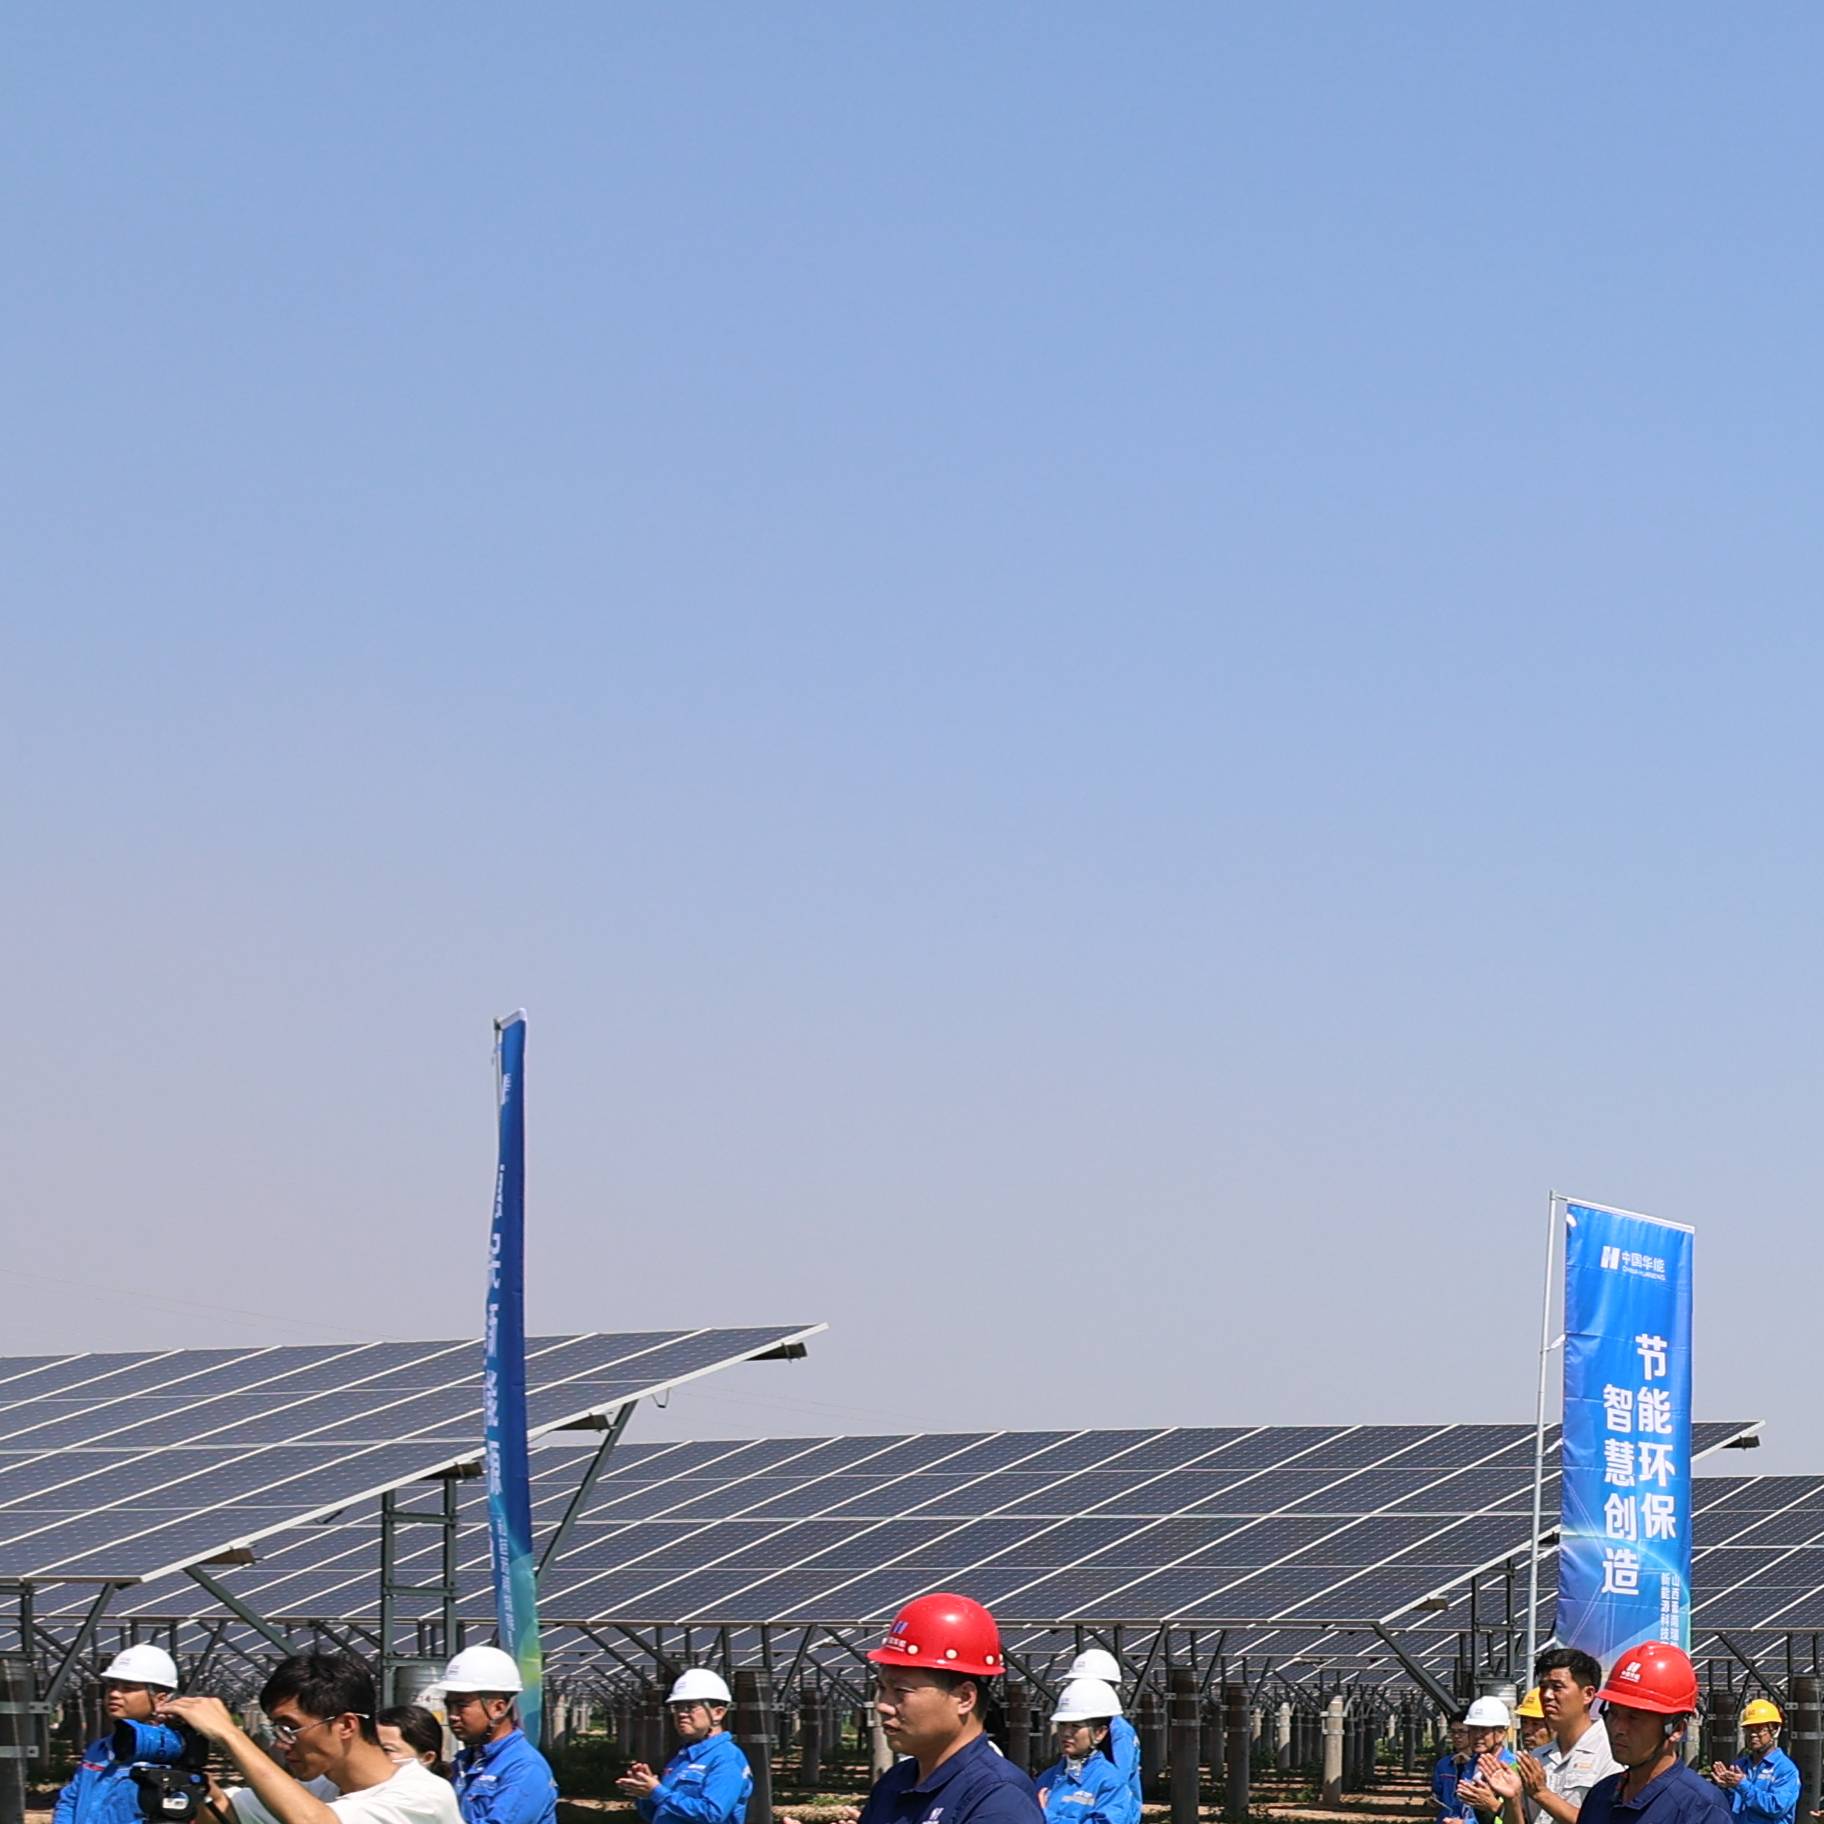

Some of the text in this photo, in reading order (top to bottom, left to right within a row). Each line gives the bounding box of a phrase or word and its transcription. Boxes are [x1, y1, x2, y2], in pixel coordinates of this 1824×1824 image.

[1622, 1249, 1665, 1273] 中国华能
[1602, 1384, 1639, 1597] 智慧创造
[1636, 1333, 1676, 1541] 节能环保
[1659, 1572, 1671, 1645] 新能源科技
